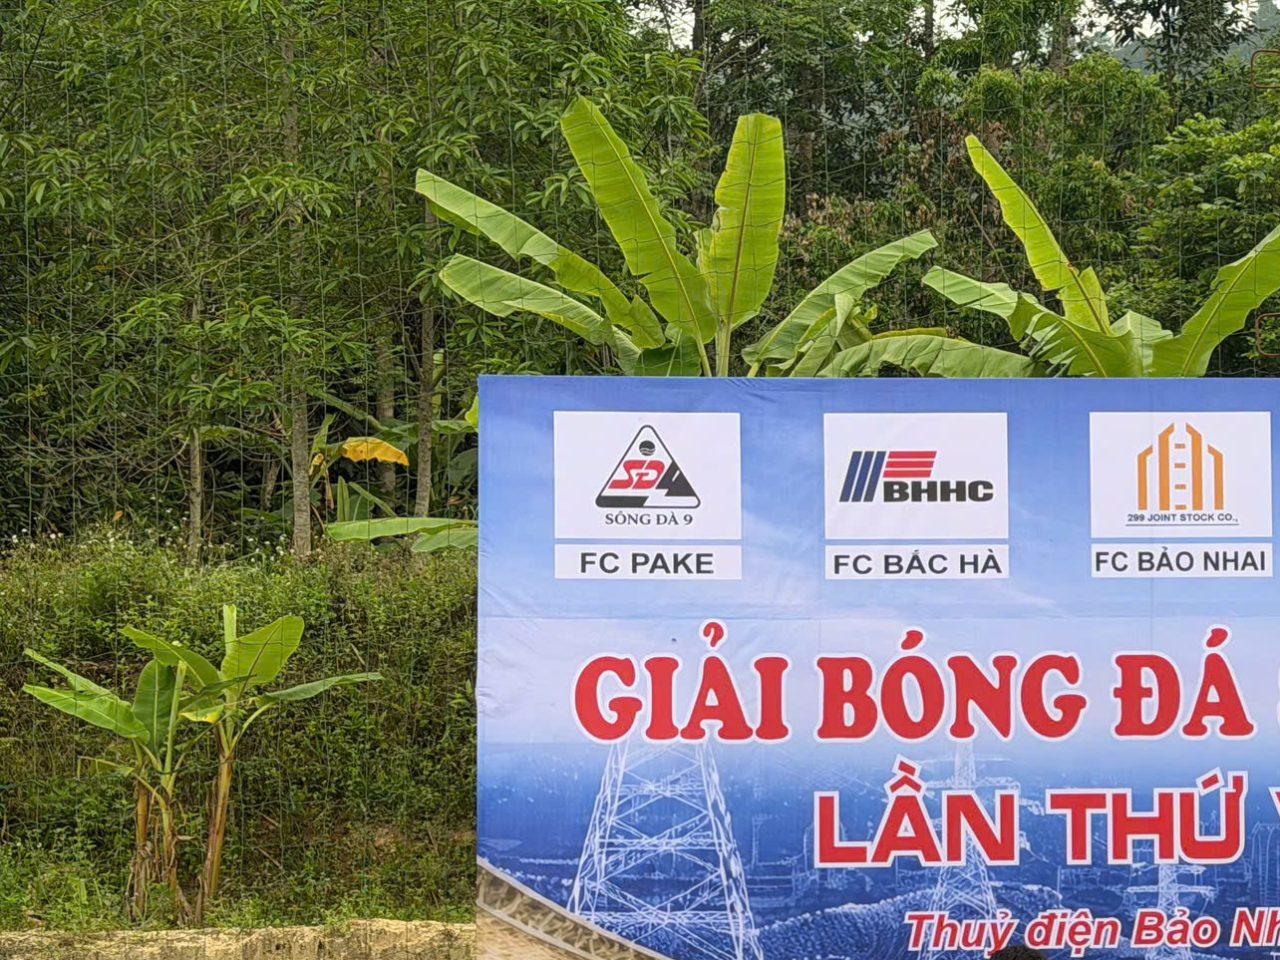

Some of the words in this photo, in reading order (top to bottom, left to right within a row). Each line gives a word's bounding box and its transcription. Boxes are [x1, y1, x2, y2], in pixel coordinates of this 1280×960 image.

[883, 480, 994, 503] BHHC
[656, 511, 680, 526] ĐÀ
[683, 513, 694, 526] 9
[1127, 513, 1146, 523] 299
[1148, 513, 1178, 523] JOINT
[1180, 512, 1216, 523] STOCK
[580, 552, 620, 574] FC
[631, 552, 714, 574] PAKE
[834, 554, 873, 575] FC
[883, 549, 948, 575] BẮC
[959, 548, 1002, 574] HÀ
[1095, 551, 1128, 572] FC
[1138, 546, 1194, 572] BẢO
[1203, 550, 1266, 572] NHAI
[575, 622, 789, 741] GIẢI
[817, 630, 1087, 740] BÓNG
[1113, 628, 1254, 737] ĐÁ
[818, 762, 1016, 864] LẦN
[1050, 775, 1244, 862] THỨ
[1023, 908, 1122, 956] điện
[1130, 908, 1222, 948] Bảo
